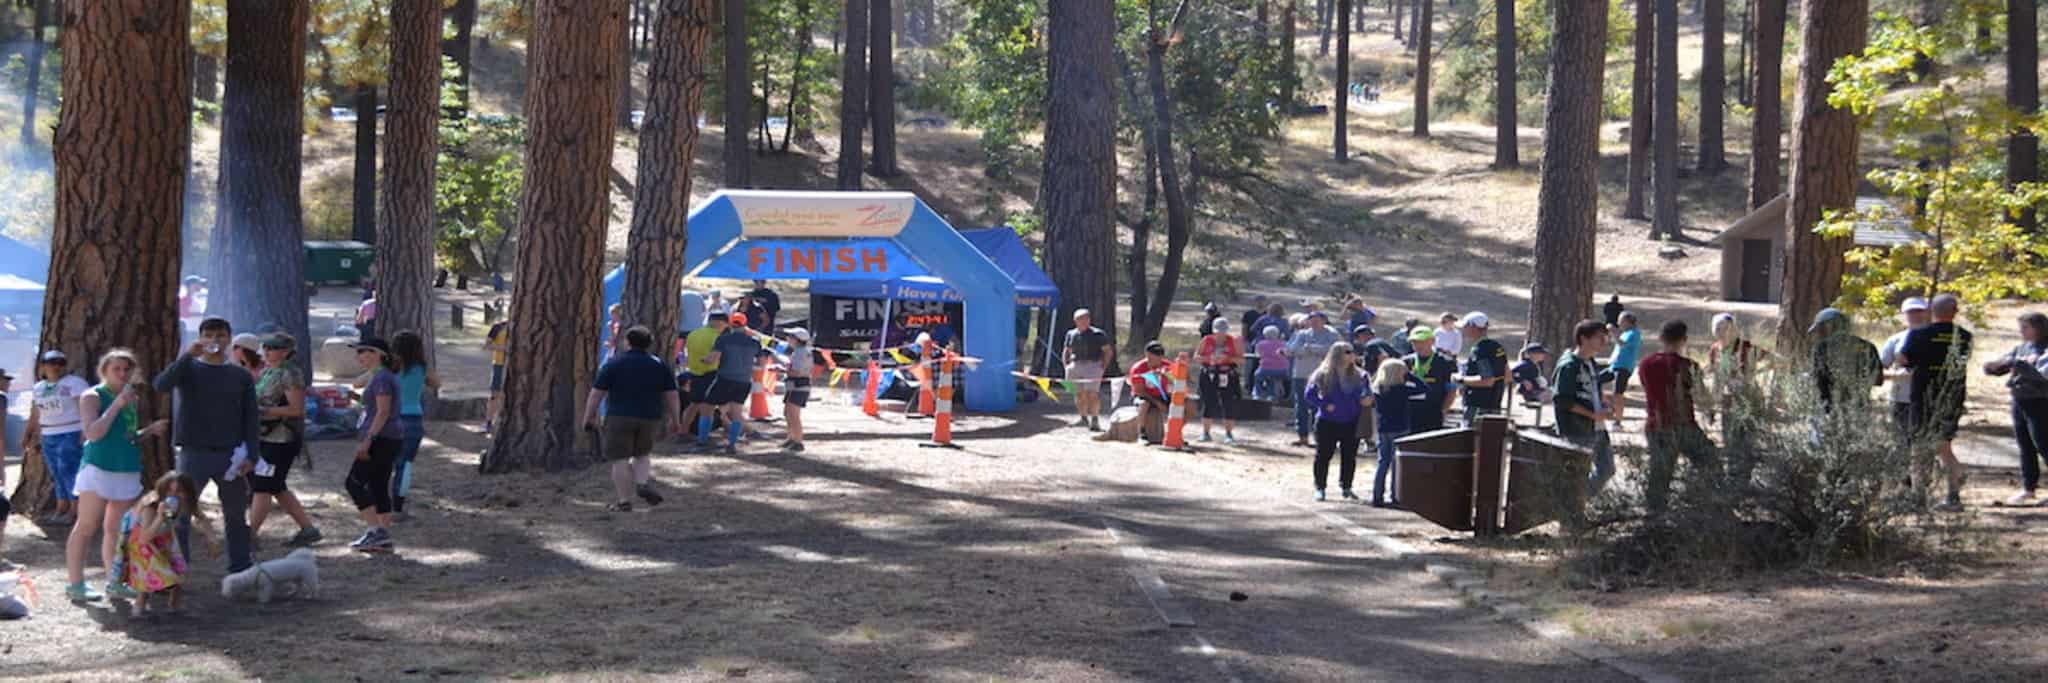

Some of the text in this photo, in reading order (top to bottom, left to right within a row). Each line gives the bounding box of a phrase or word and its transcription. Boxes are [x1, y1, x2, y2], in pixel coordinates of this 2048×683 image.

[748, 248, 887, 273] FINISH
[897, 286, 937, 299] Have
[835, 299, 944, 321] FINISH
